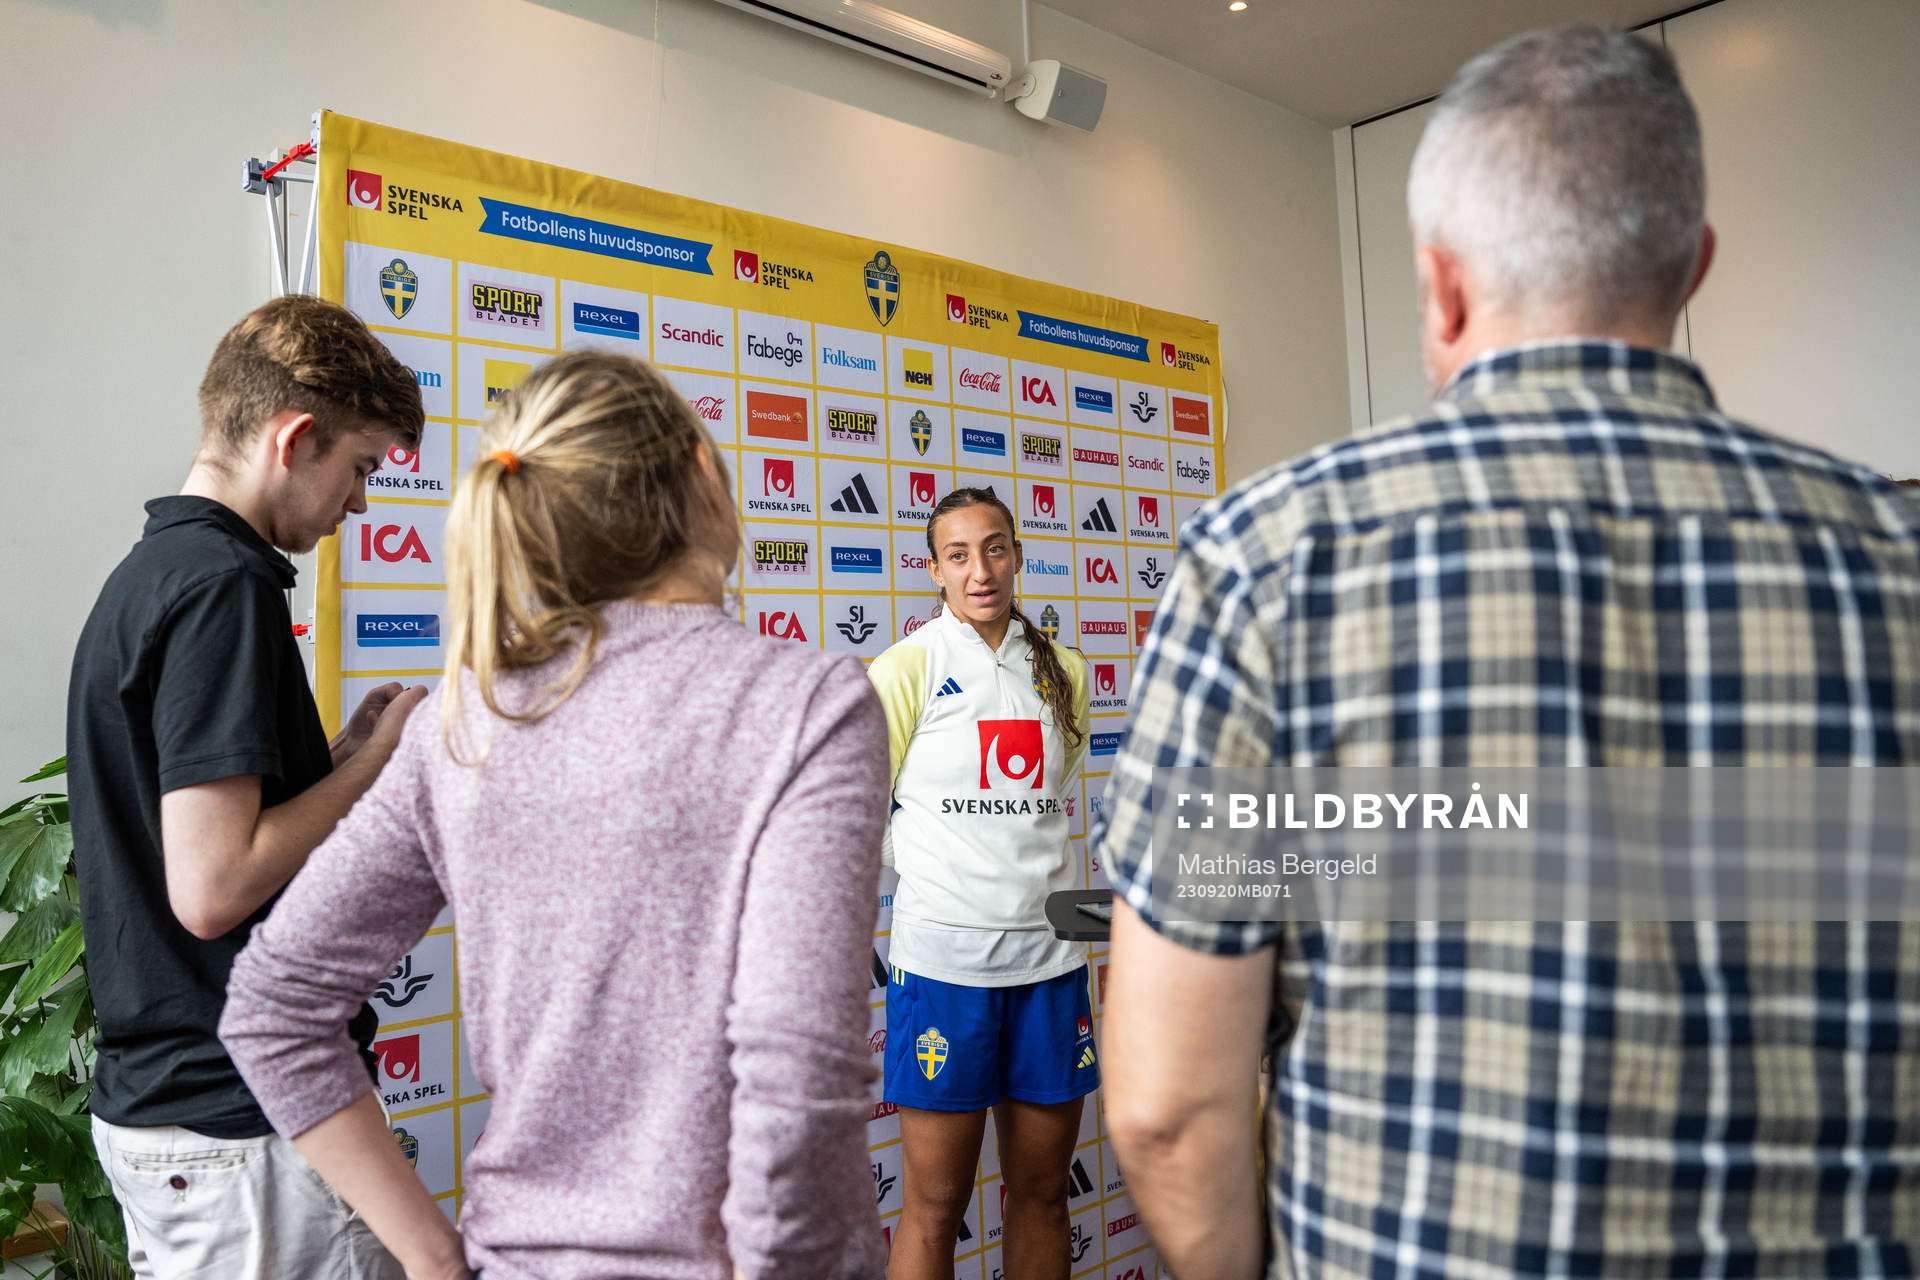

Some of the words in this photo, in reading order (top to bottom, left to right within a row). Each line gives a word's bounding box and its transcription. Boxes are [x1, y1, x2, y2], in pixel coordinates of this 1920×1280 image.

[388, 185, 463, 213] SVENSKA
[388, 201, 428, 221] SPEL
[502, 210, 586, 242] Fotbollens
[589, 228, 695, 263] huvudsponsor
[762, 262, 814, 282] SVENSKA
[762, 275, 790, 290] SPEL
[473, 284, 543, 319] SPORT
[476, 311, 540, 328] BLADET
[968, 304, 1009, 323] SVENSKA
[969, 318, 991, 330] SPEL
[661, 323, 724, 347] Scandic
[1029, 319, 1077, 341] Fotbollens
[1078, 332, 1140, 354] huvudsponsor
[747, 334, 803, 367] Fabege
[1177, 350, 1210, 366] SVENSKA
[822, 347, 877, 372] Folksam
[1178, 360, 1196, 372] SPEL
[959, 368, 1001, 393] Coca-Cola
[1021, 375, 1057, 407] ICA
[1139, 391, 1149, 407] SJ
[752, 409, 791, 422] Swedbank
[828, 409, 877, 434] SPORT
[831, 432, 876, 442] BLADET
[1022, 435, 1061, 458] SPORT
[1024, 455, 1060, 465] BLADET
[1074, 450, 1118, 464] BAUHAUS
[1128, 456, 1164, 472] Scandic
[1176, 461, 1210, 484] Fabege
[367, 476, 410, 489] ENSKA
[414, 479, 444, 491] SPEL
[748, 500, 789, 512] SVENSKA
[791, 502, 812, 513] SPEL
[897, 510, 931, 520] SVENSKA
[1022, 520, 1052, 529] SVENSKA
[1053, 522, 1068, 531] SPEL
[361, 523, 432, 563] ICA
[1130, 529, 1155, 538] SVENSKA
[1157, 531, 1170, 540] SPEL
[755, 541, 808, 565] SPORT
[758, 564, 807, 572] BLADET
[1026, 558, 1069, 576] Folksam
[1085, 557, 1119, 584] ICA
[1146, 557, 1157, 573] SJ
[849, 605, 864, 622] SJ
[759, 611, 808, 643] ICA
[1081, 622, 1126, 633] BAUHAUS
[1113, 698, 1127, 706] SPEL
[941, 798, 1032, 815] SVENSKA
[1037, 798, 1061, 814] SPE
[414, 1083, 446, 1100] SPEL
[1108, 1215, 1135, 1235] BAUH
